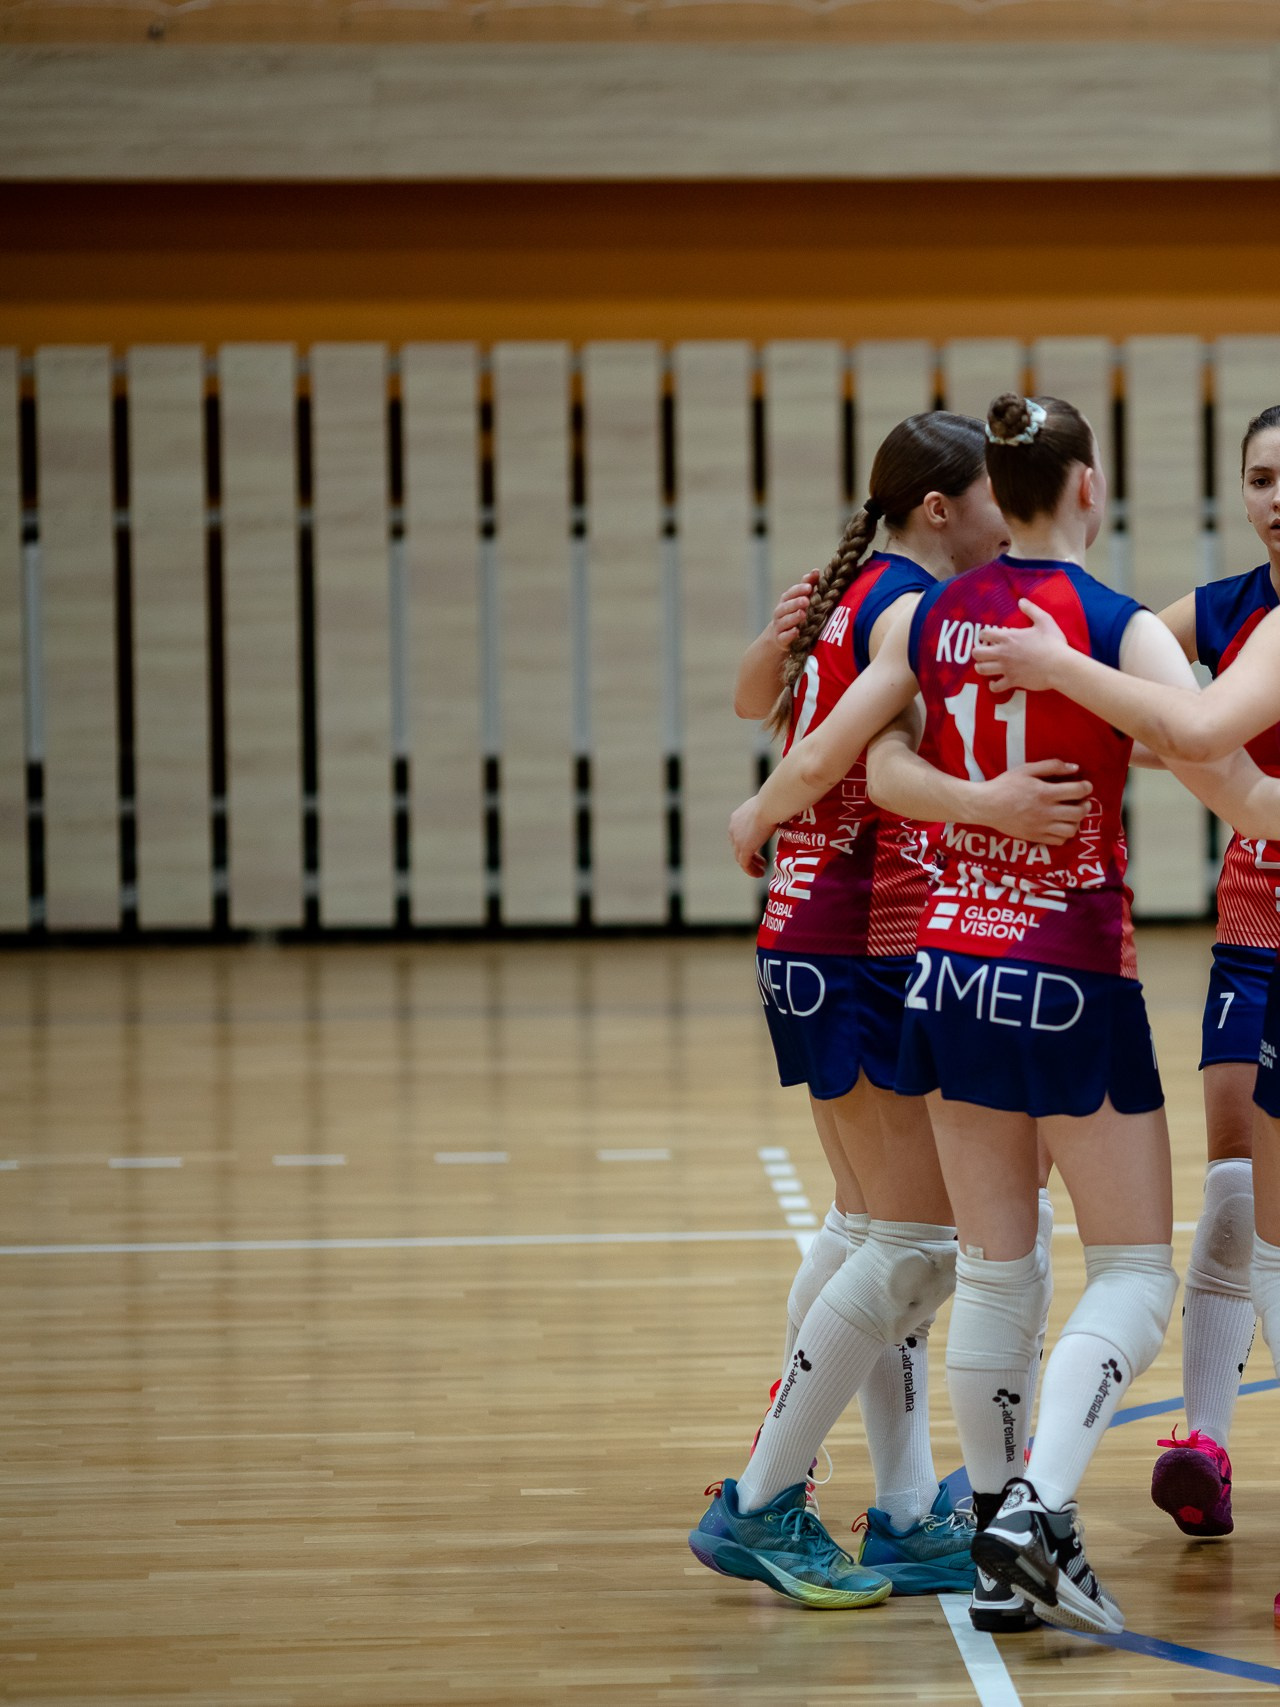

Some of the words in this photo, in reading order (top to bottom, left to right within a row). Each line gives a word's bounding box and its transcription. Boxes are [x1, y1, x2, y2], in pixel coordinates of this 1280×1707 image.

[944, 682, 1027, 783] 11
[942, 821, 1052, 866] ИСКРА
[958, 919, 1026, 942] VISION
[964, 905, 1040, 929] GLOBAL
[904, 950, 1085, 1032] 2MED
[1217, 992, 1235, 1029] 7
